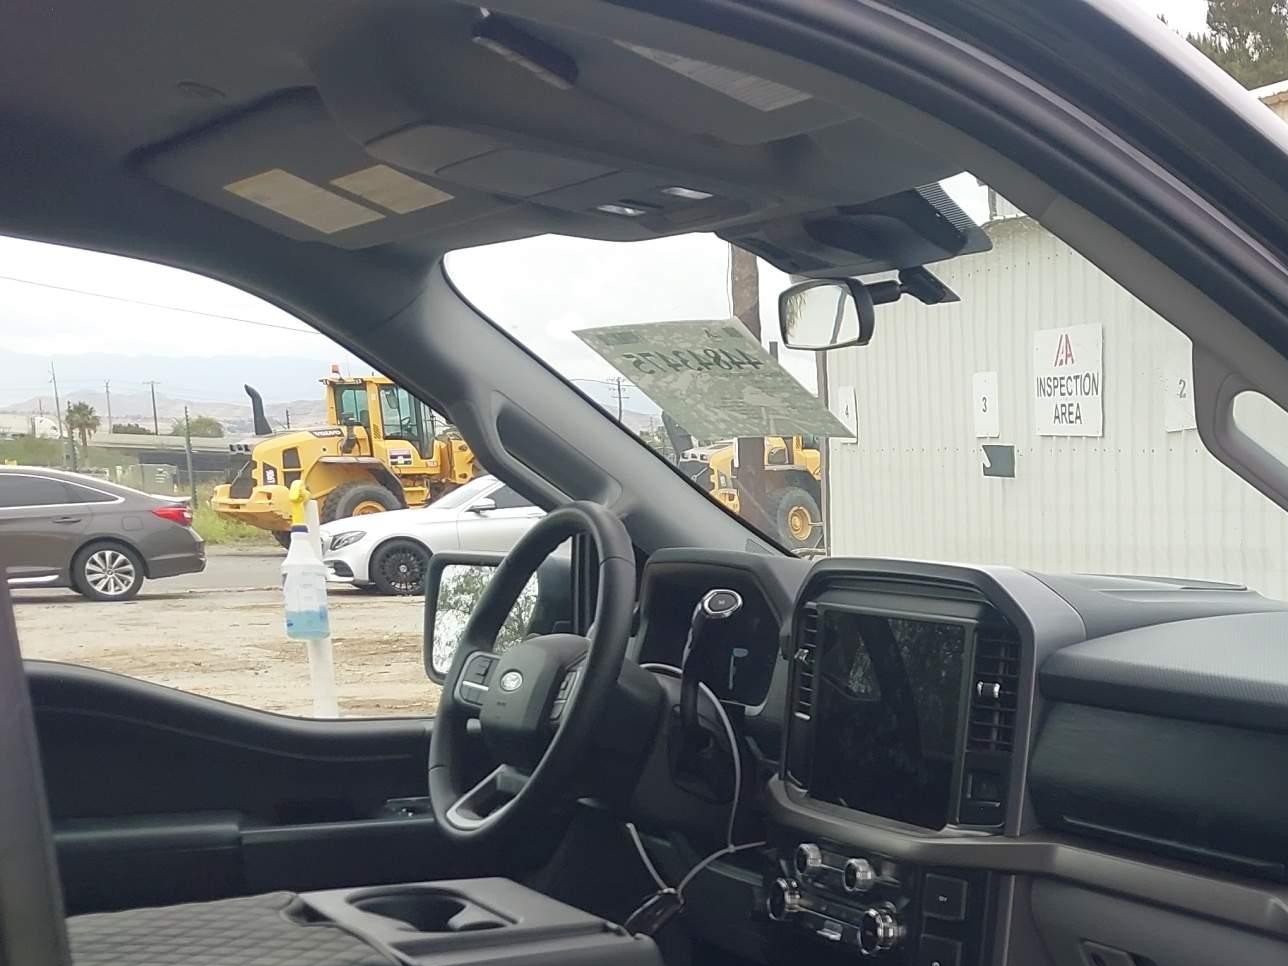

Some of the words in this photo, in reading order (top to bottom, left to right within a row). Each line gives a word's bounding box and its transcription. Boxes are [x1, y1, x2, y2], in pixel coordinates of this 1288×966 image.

[1036, 371, 1099, 397] INSPECTION
[1177, 379, 1186, 399] 2
[981, 396, 987, 412] 3
[1053, 402, 1082, 424] AREA
